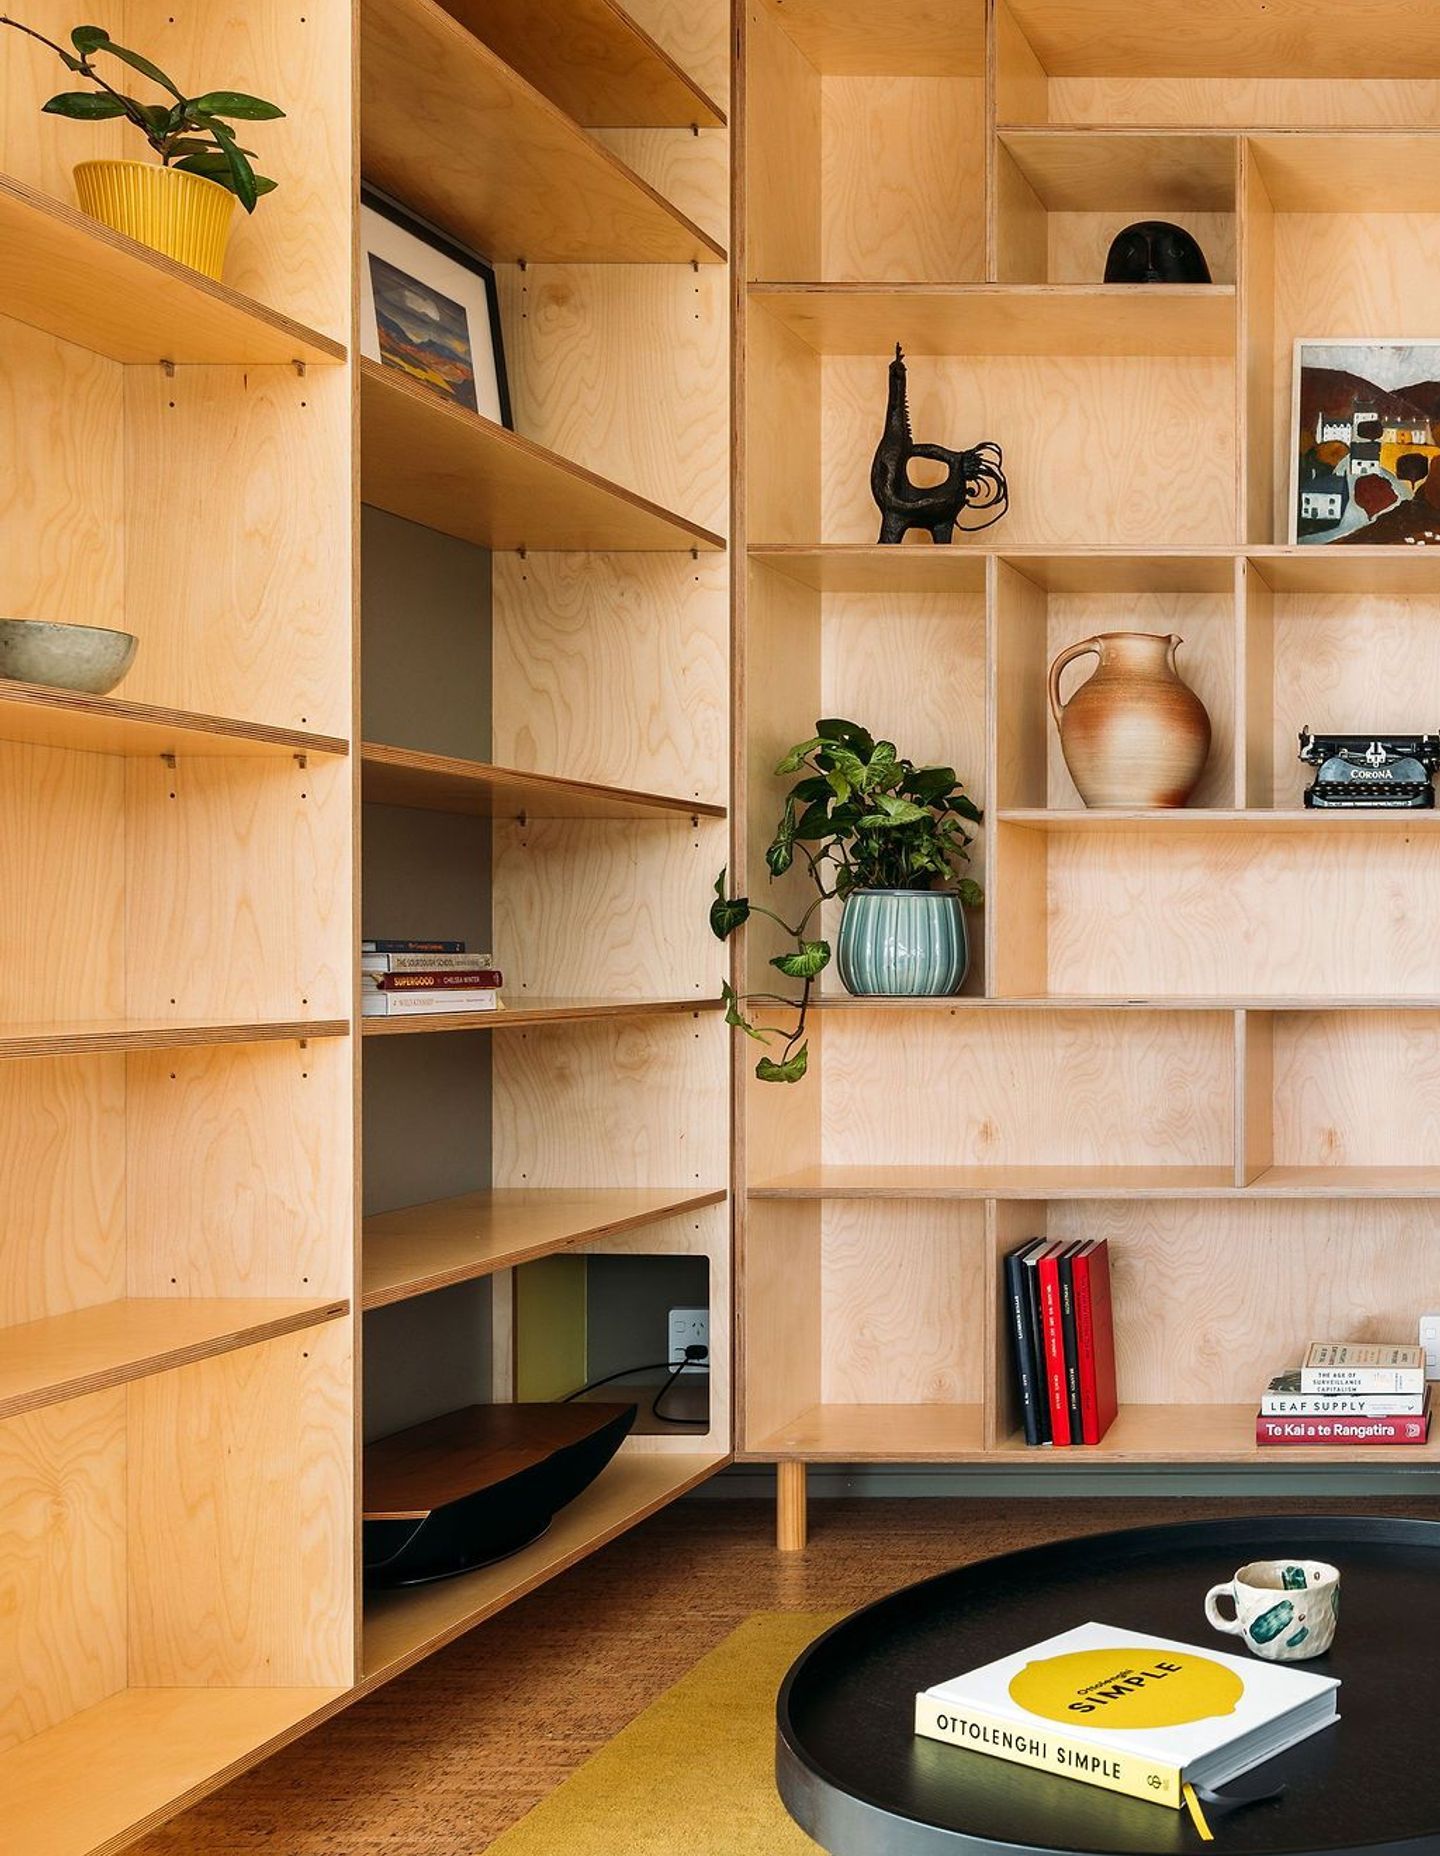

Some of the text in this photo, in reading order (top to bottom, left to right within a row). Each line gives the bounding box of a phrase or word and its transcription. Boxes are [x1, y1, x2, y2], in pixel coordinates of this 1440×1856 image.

[1350, 769, 1393, 779] CORONA
[393, 976, 435, 986] SUPERGOOD
[1271, 1402, 1307, 1411] LEAF
[1314, 1402, 1366, 1411] SUPPLY
[1265, 1423, 1395, 1438] Te Kai a te Rangatira
[1068, 1662, 1183, 1713] SIMPLE
[1077, 1669, 1135, 1695] Ottolenghi
[936, 1714, 1122, 1780] OTTOLENGHI SIMPLE
